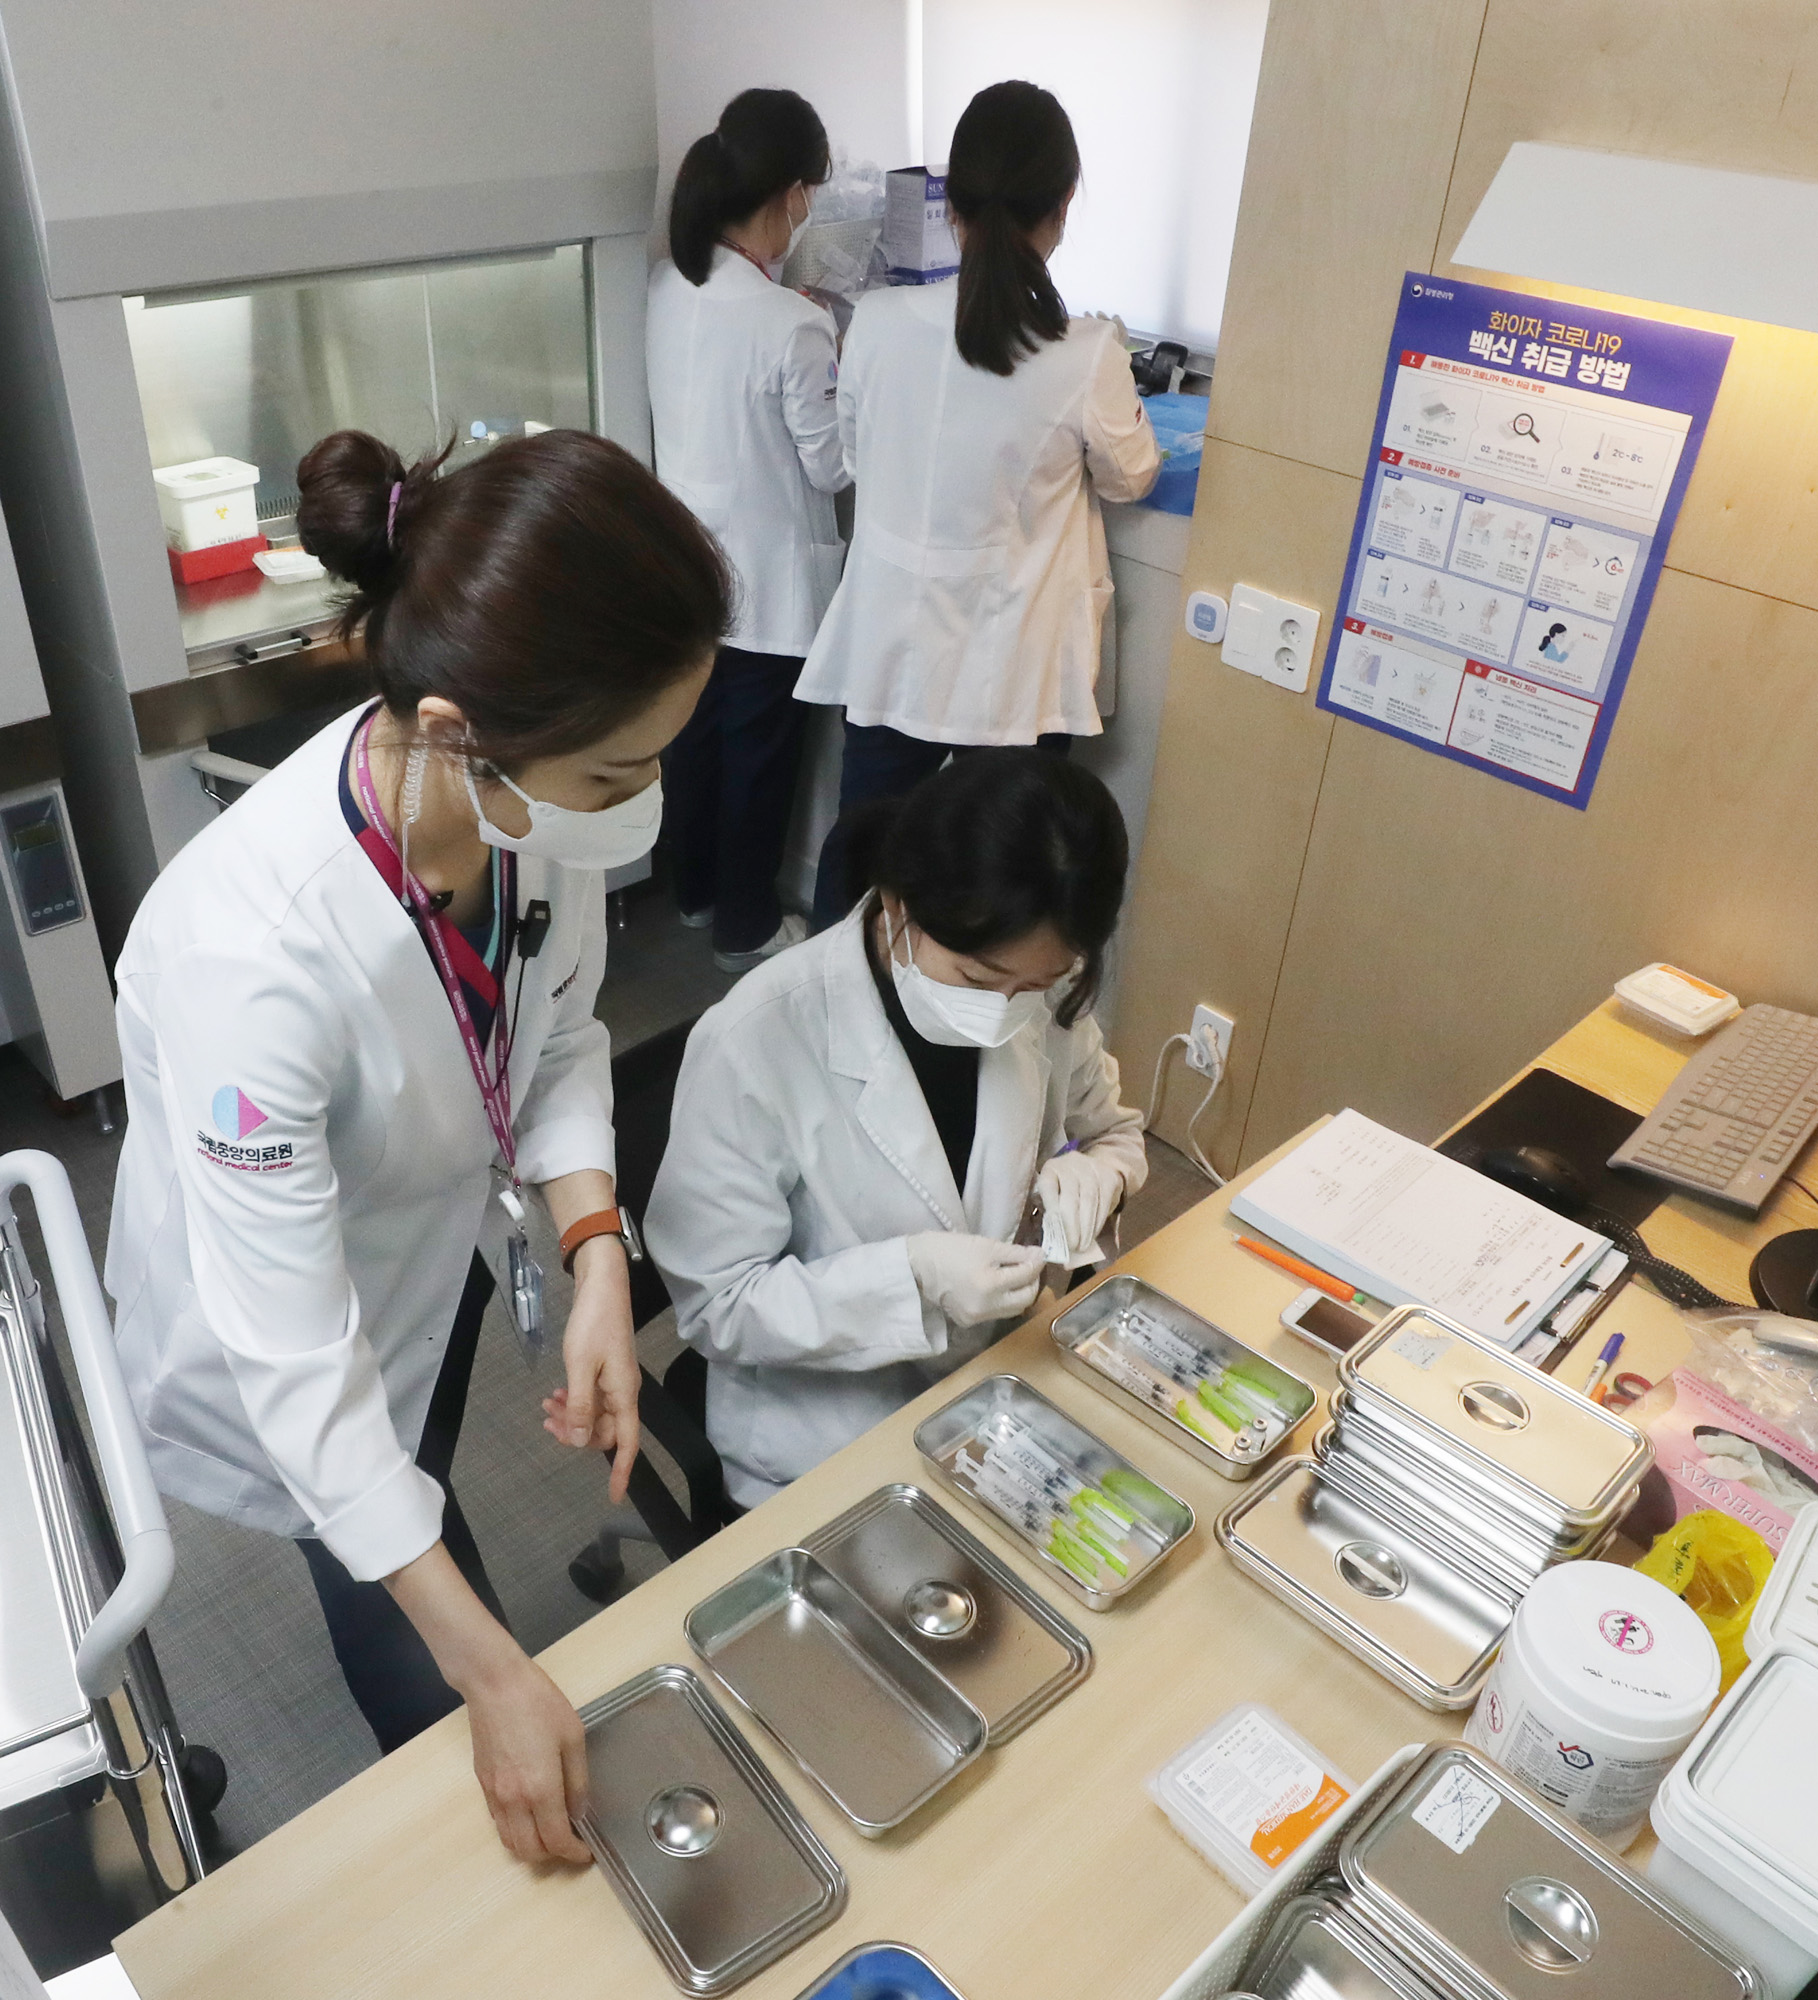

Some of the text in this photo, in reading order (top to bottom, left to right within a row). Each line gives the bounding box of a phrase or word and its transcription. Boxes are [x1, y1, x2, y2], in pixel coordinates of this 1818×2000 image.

[1488, 310, 1622, 356] 화이자 코로나19
[1468, 330, 1632, 392] 백신 취급 방법
[1452, 364, 1472, 376] 화이자
[1472, 369, 1500, 382] 코로나19
[1501, 374, 1515, 386] 백신
[1516, 378, 1530, 390] 취급
[1531, 382, 1546, 394] 방법
[362, 786, 376, 814] national
[197, 1130, 293, 1162] 국립중앙의료원
[198, 1148, 294, 1172] national medical center
[1678, 1461, 1790, 1541] SUPER MAX
[1286, 1798, 1300, 1813] HAN
[1298, 1787, 1312, 1801] DAE
[1260, 1809, 1288, 1835] MEDICAL
